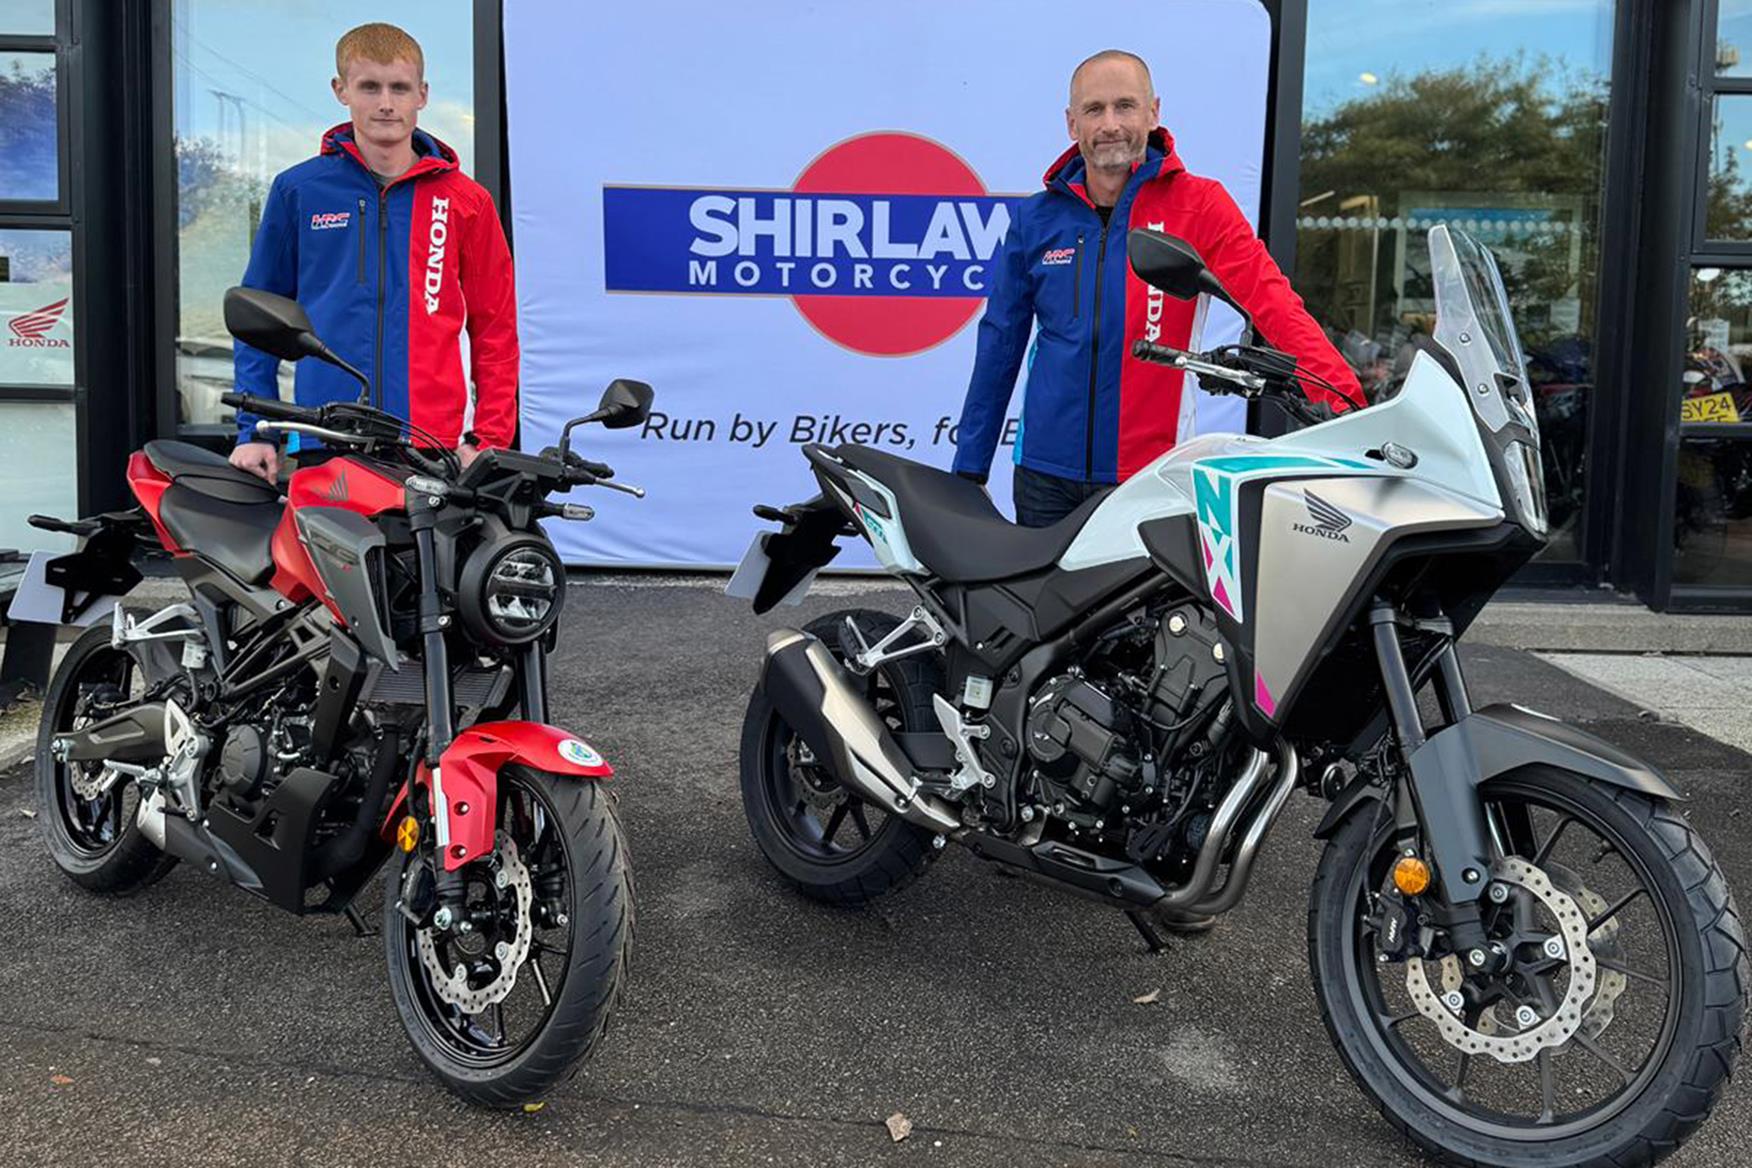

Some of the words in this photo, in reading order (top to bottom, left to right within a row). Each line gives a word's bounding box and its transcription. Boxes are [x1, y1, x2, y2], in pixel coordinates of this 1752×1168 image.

[689, 195, 1012, 260] SHIRLAW
[424, 195, 449, 316] HONDA
[689, 260, 985, 290] MOTORCYC
[9, 338, 71, 348] HONDA
[640, 412, 716, 441] Run
[729, 413, 778, 448] by
[789, 415, 915, 450] Bikers,
[1293, 522, 1350, 543] HONDA
